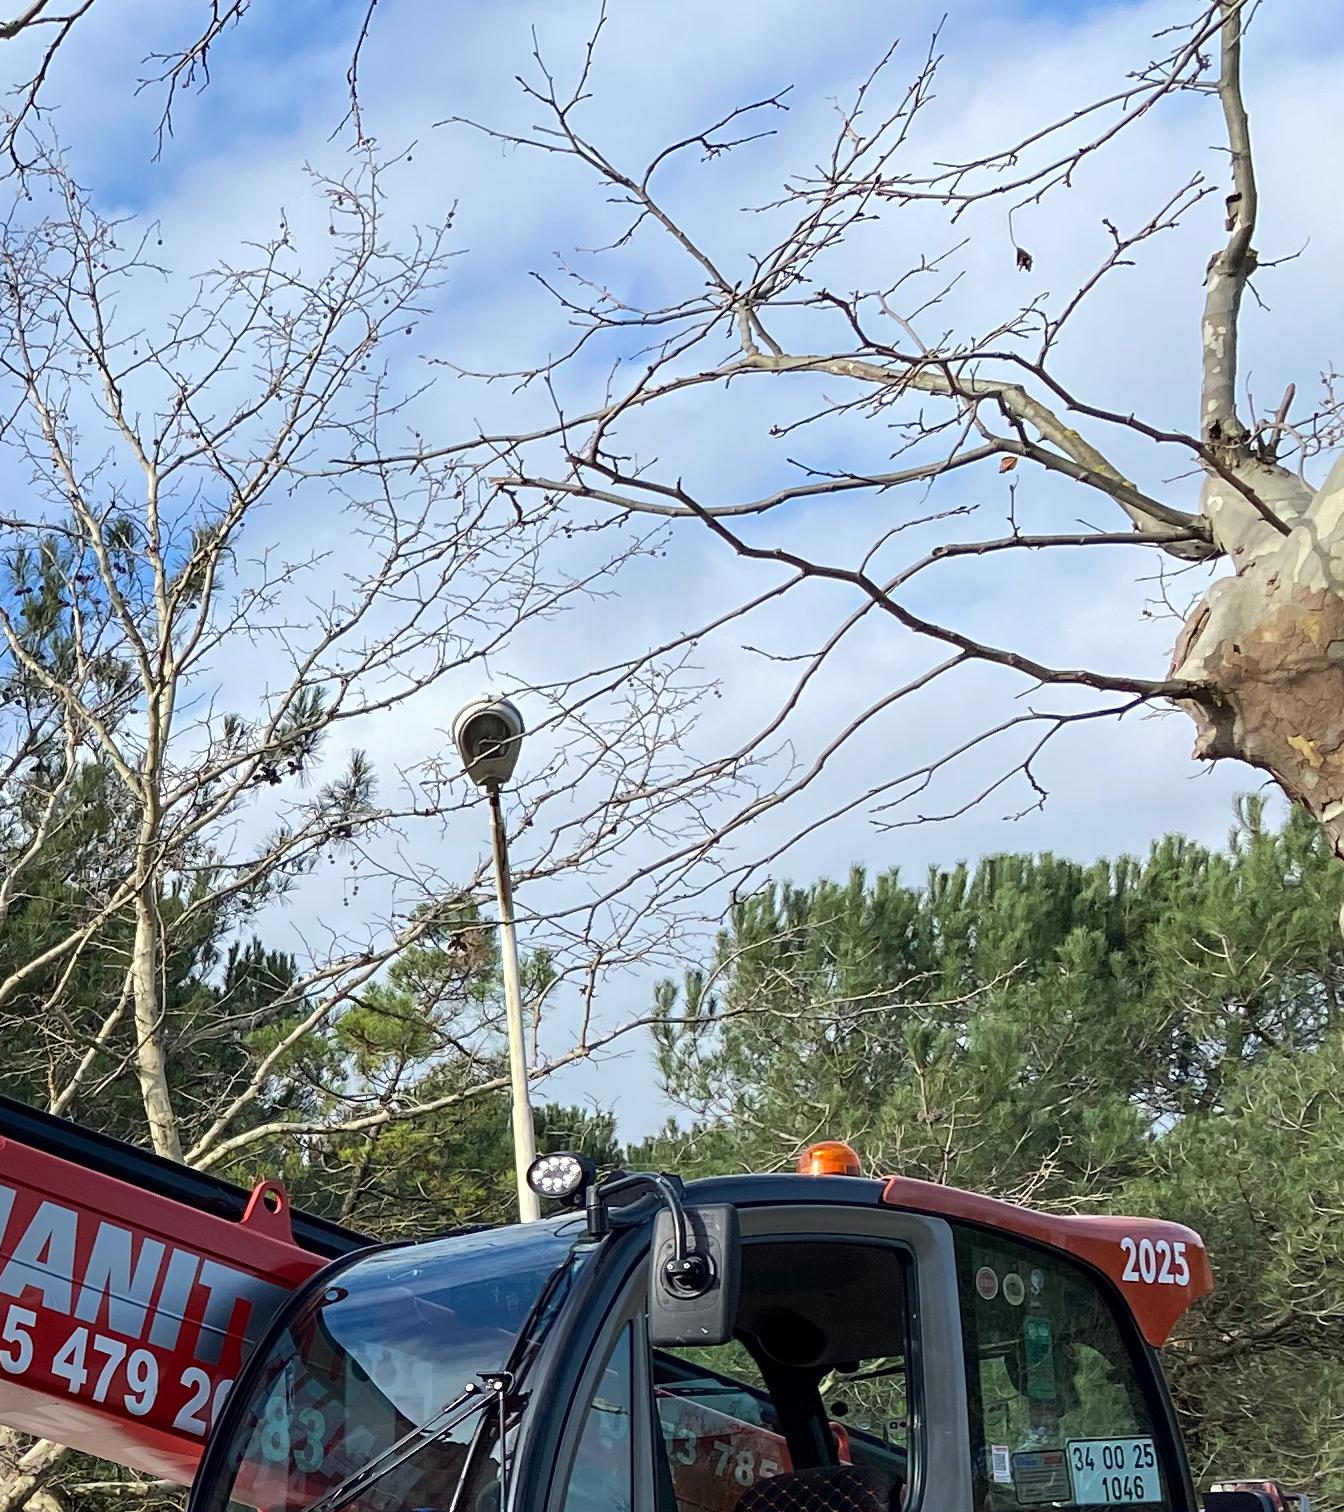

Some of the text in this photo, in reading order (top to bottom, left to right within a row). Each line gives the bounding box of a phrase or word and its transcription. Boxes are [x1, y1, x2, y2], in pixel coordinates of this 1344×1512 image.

[1119, 1236, 1190, 1286] 2025
[51, 1326, 159, 1417] 479
[1073, 1443, 1155, 1472] 34 00 25
[1101, 1475, 1145, 1502] 1046
